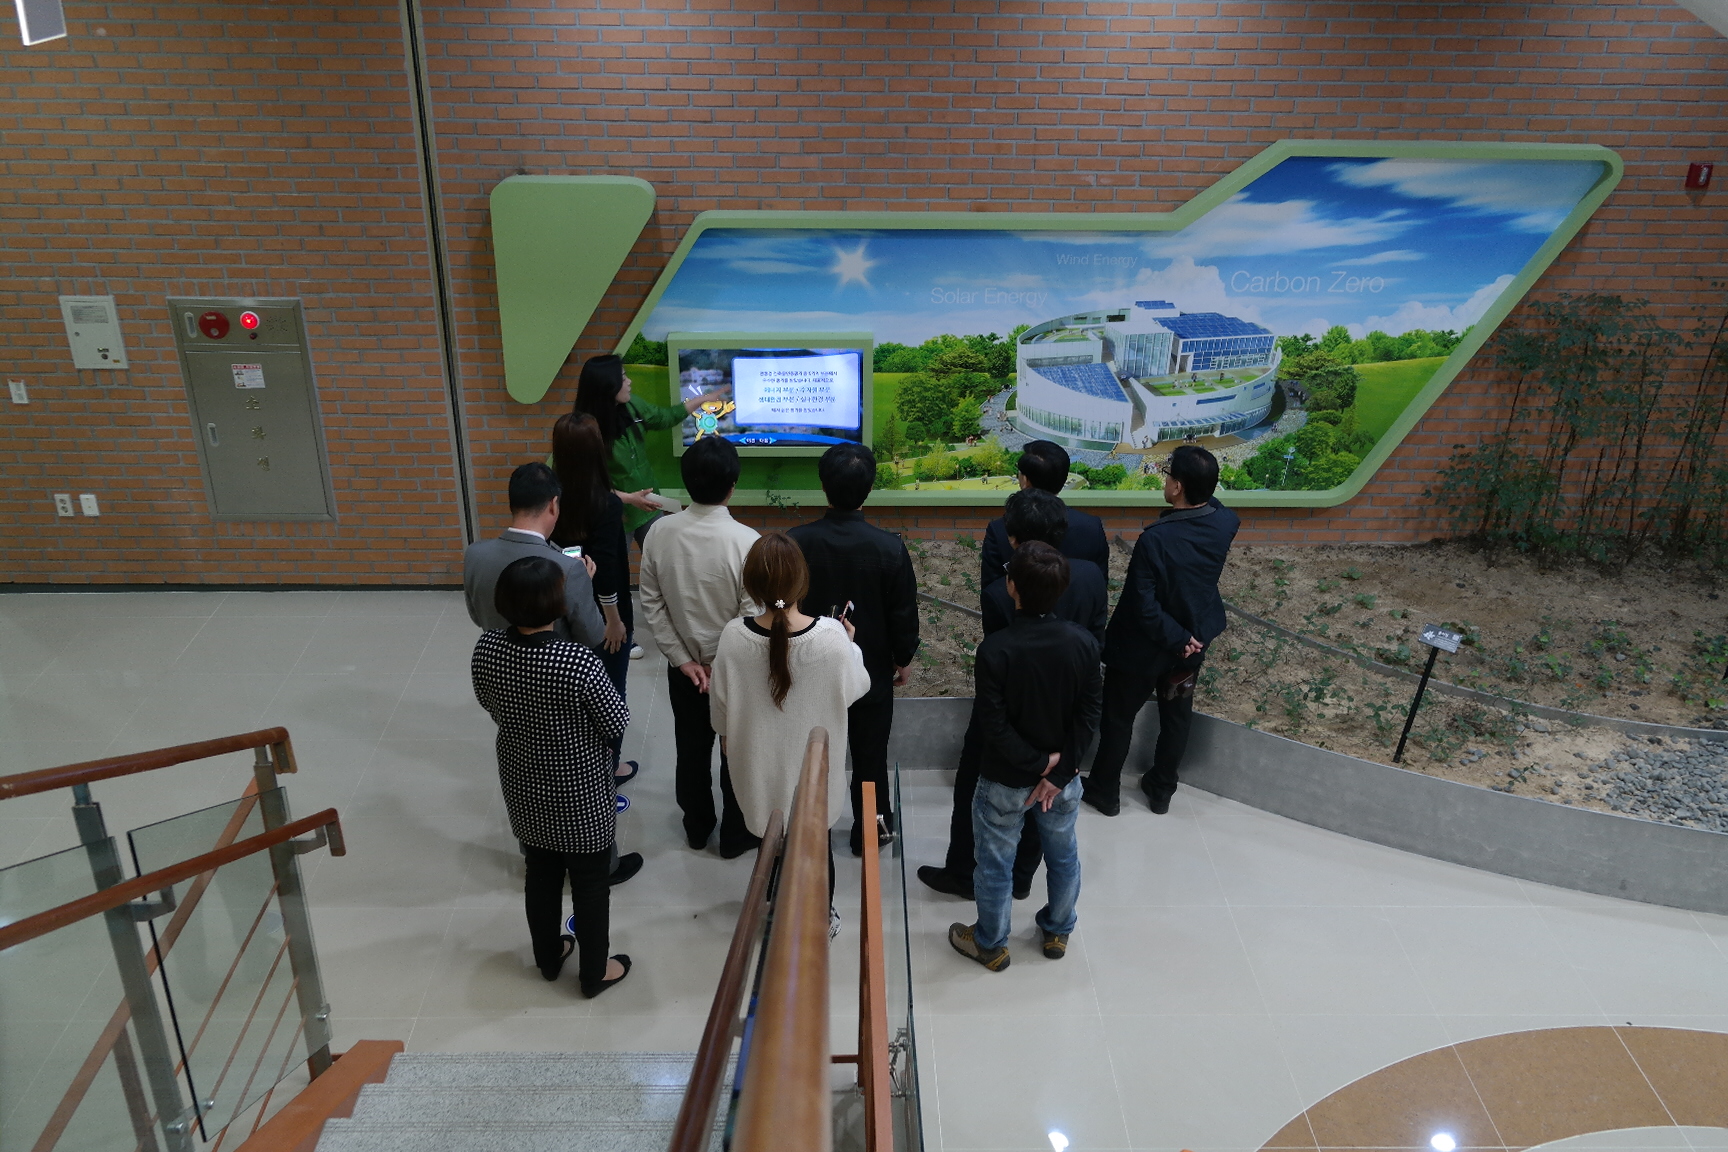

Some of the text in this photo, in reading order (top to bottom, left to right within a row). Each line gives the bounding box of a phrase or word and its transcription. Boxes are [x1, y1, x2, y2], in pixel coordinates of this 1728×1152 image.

[1056, 253, 1138, 269] Wind Energy
[1230, 270, 1385, 293] Carbon Zero
[930, 287, 1048, 308] Solar Energy
